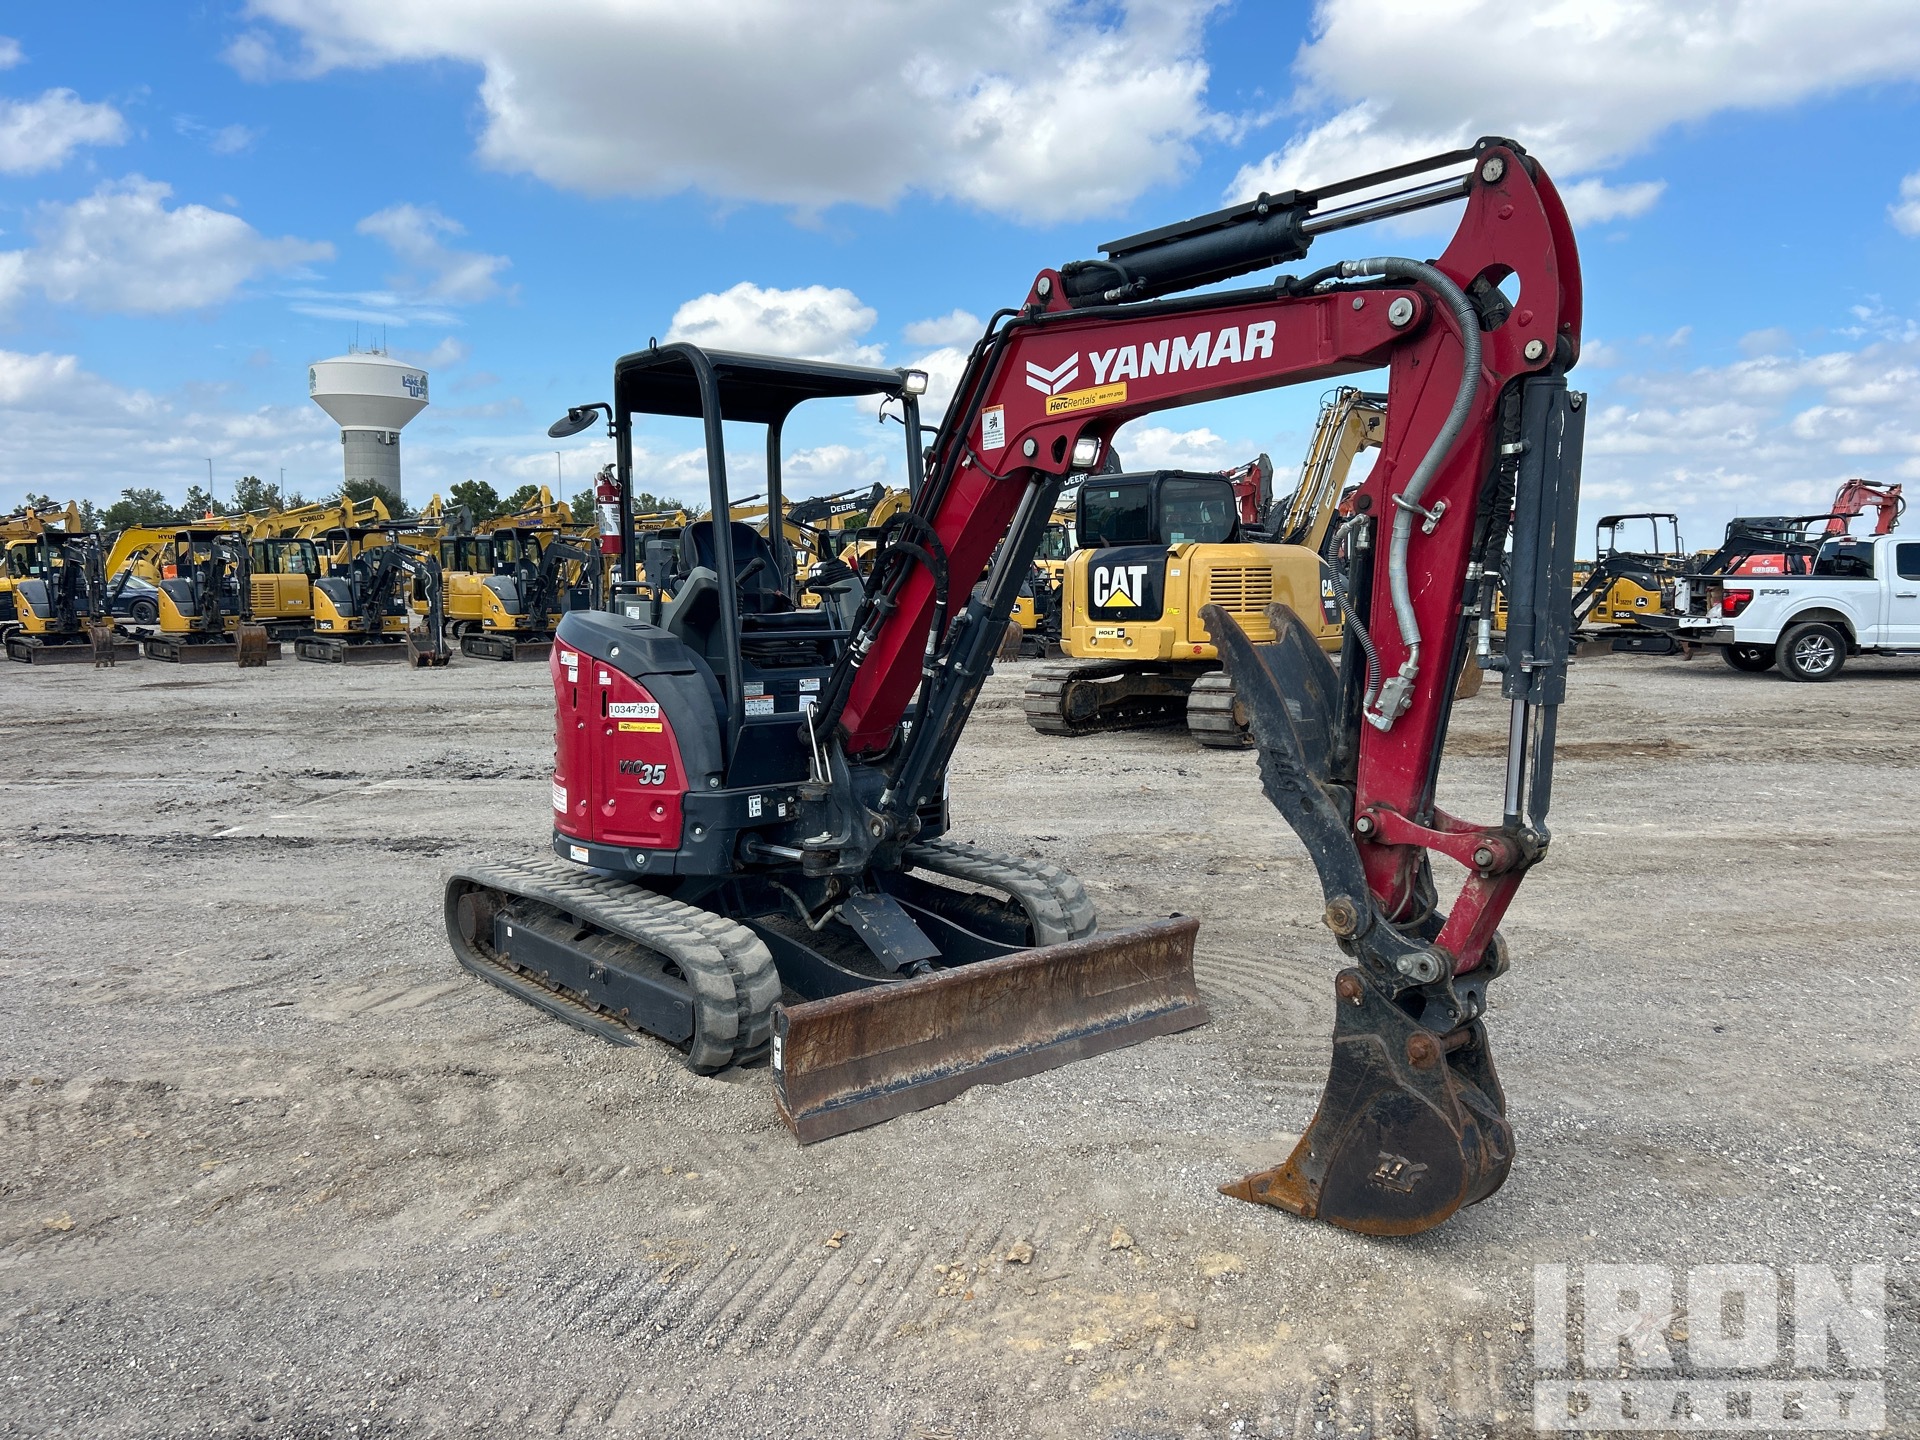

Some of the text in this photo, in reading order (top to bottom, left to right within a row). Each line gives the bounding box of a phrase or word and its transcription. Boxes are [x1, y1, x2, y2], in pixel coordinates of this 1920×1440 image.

[1088, 320, 1277, 385] YANMAR
[830, 502, 857, 514] DEERE
[299, 513, 325, 523] KOBELCO
[802, 538, 812, 548] CAT
[796, 550, 807, 566] AT
[1093, 565, 1148, 608] CAT
[1321, 579, 1336, 598] CA
[1759, 588, 1790, 597] FX4
[609, 705, 657, 714] 10347395
